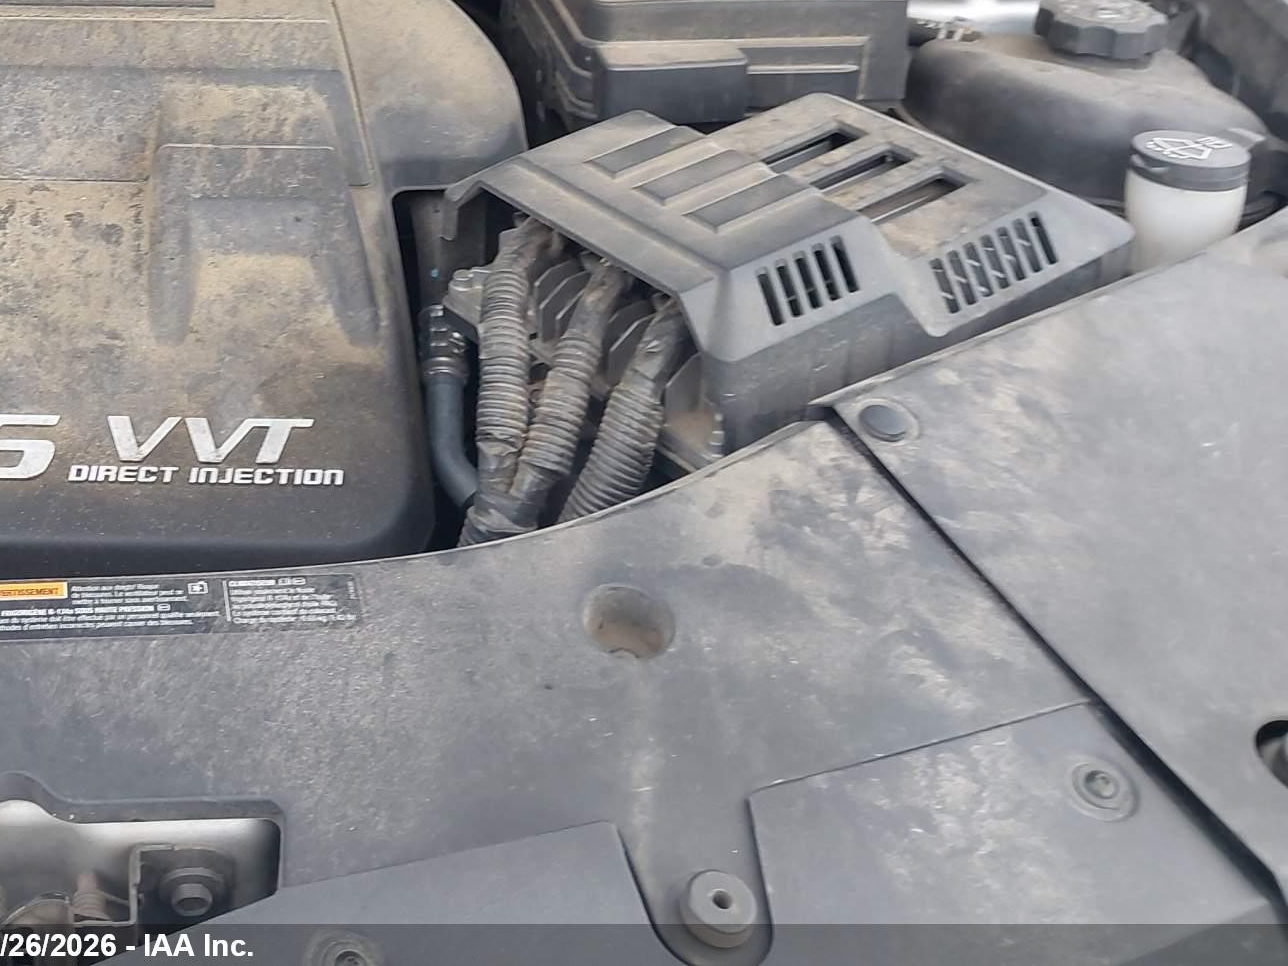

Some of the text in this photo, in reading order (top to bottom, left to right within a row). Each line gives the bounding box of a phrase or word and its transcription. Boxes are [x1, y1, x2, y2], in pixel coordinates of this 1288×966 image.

[107, 415, 314, 464] VVT
[67, 464, 344, 487] DIRECT INJECTION
